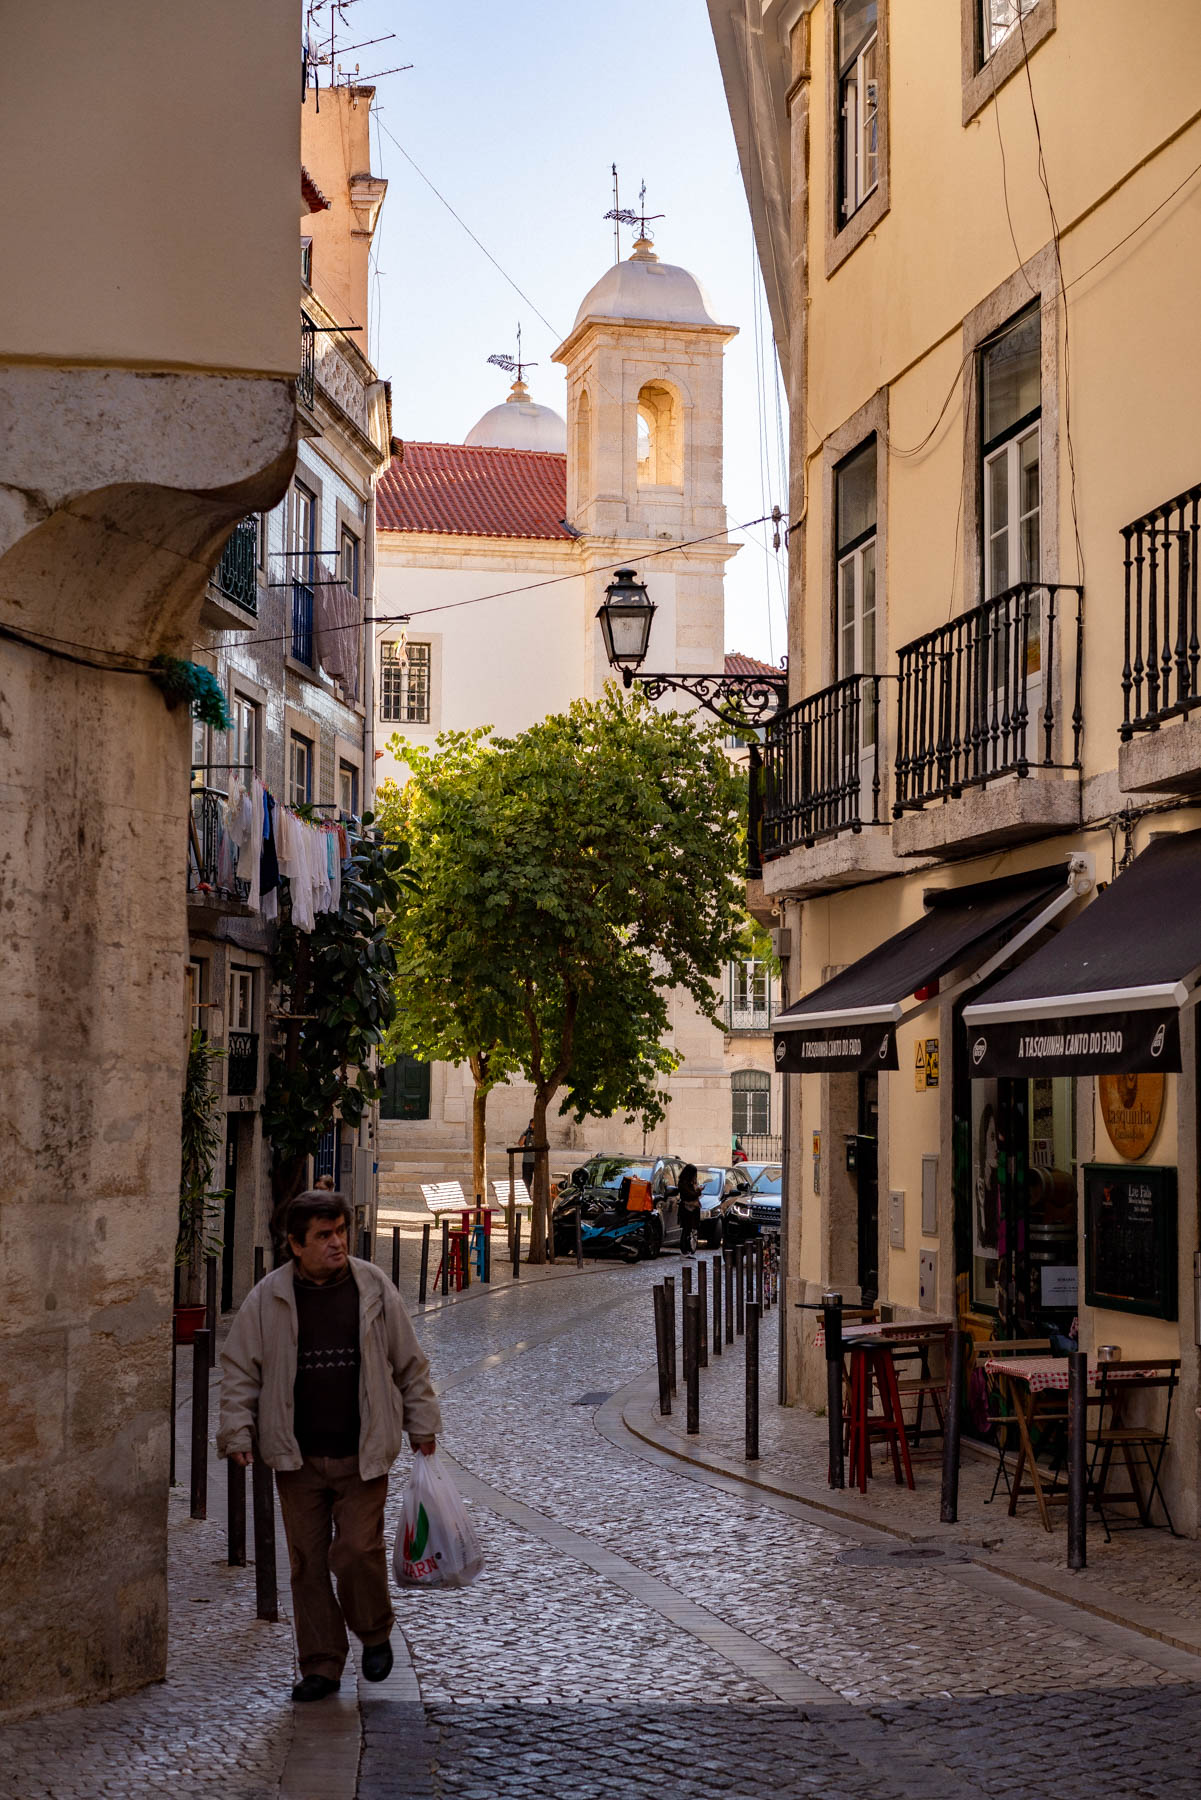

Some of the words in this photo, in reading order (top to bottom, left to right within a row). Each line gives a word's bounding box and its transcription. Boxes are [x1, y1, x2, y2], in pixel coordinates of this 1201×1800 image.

[801, 1041, 805, 1058] A
[849, 1039, 861, 1055] FADO
[1018, 1037, 1024, 1058] A
[1025, 1035, 1064, 1058] TASQUINHA
[1065, 1033, 1089, 1055] CANTO
[1089, 1032, 1100, 1054] DO
[1101, 1031, 1123, 1053] FADO
